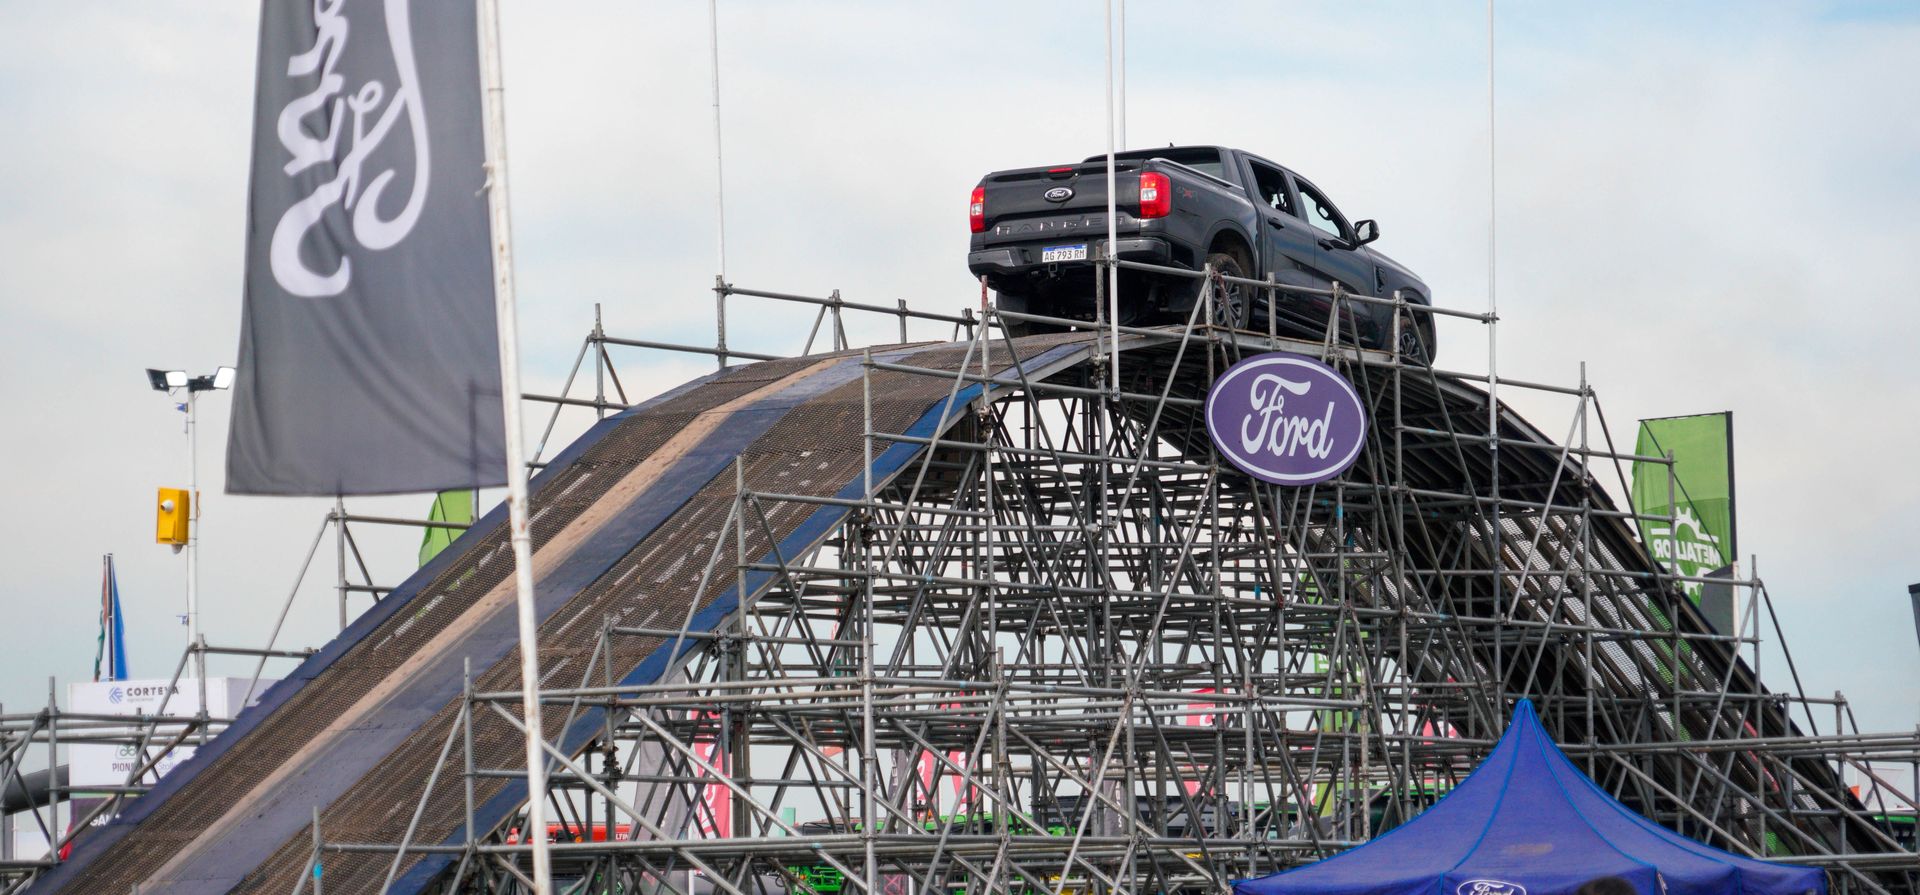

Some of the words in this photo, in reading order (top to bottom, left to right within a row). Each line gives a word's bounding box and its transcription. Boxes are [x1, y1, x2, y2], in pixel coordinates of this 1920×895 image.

[1050, 189, 1066, 198] Ford
[1044, 251, 1055, 262] AG
[1057, 250, 1073, 260] 793
[1241, 373, 1335, 460] Ford
[126, 686, 179, 697] CORTEA
